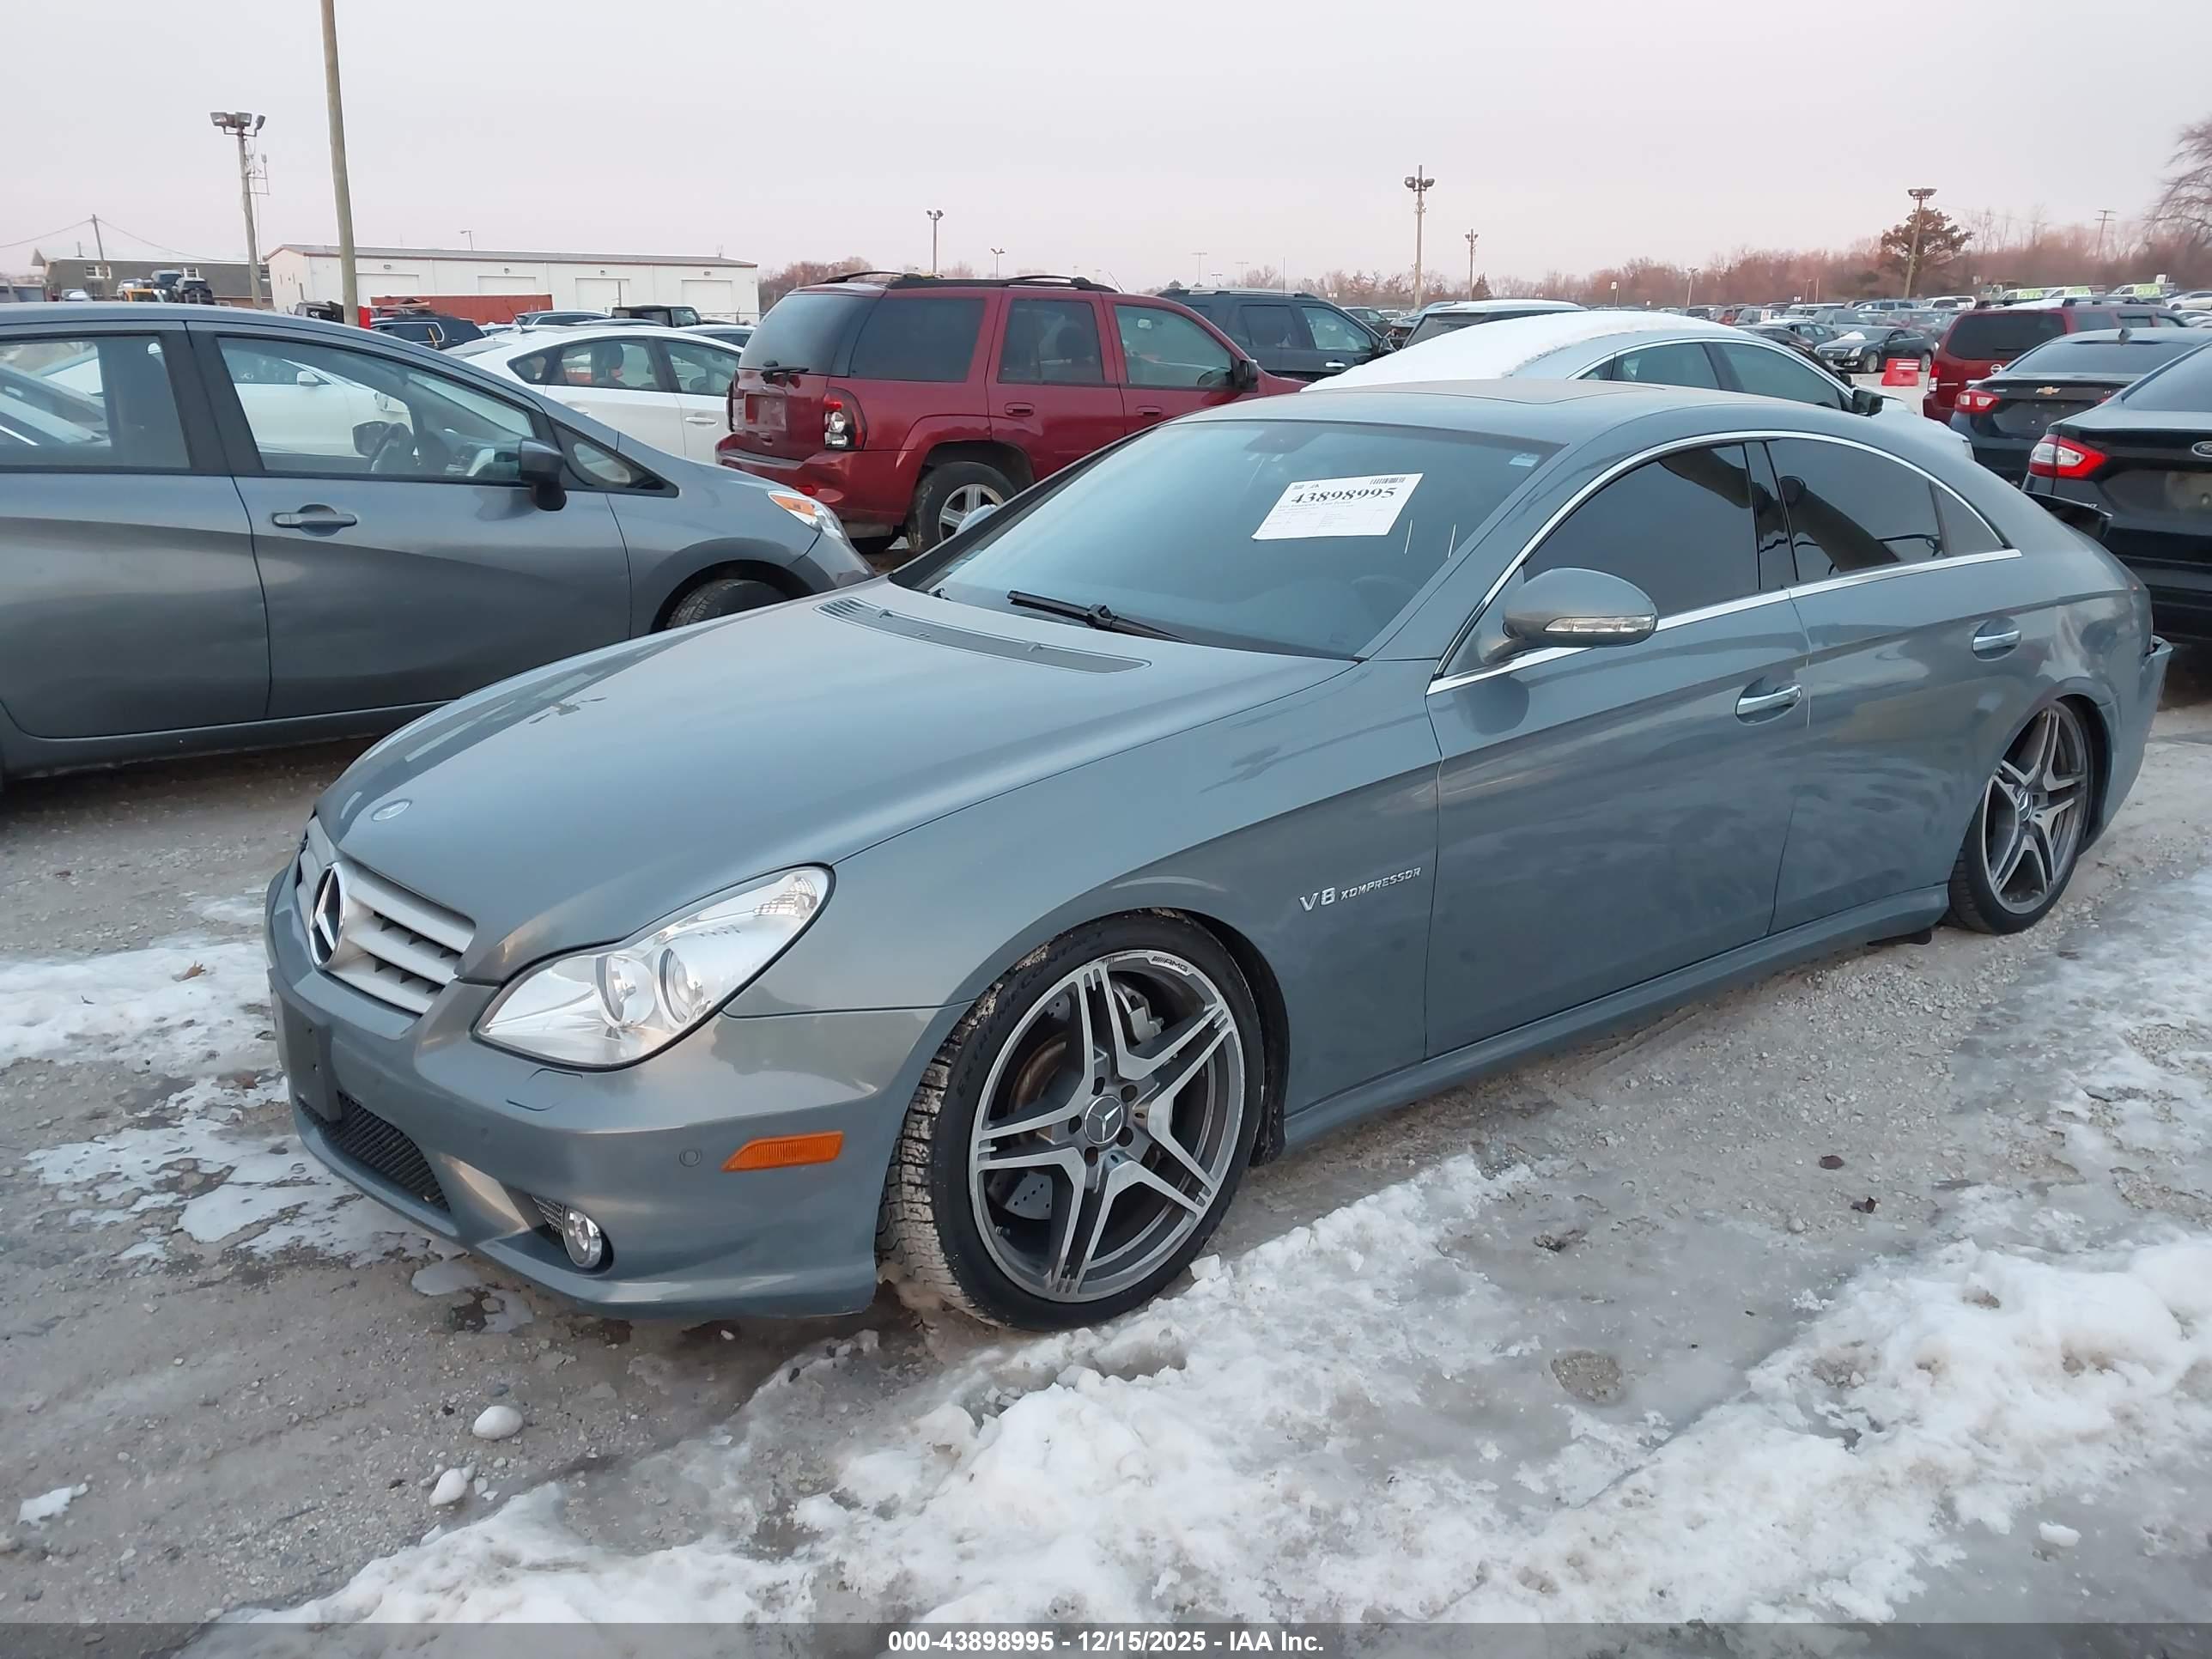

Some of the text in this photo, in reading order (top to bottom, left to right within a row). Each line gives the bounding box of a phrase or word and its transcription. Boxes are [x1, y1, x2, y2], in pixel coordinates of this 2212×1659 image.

[1291, 487, 1397, 504] 43898995
[1299, 867, 1421, 912] V8 KOMPRESSOR
